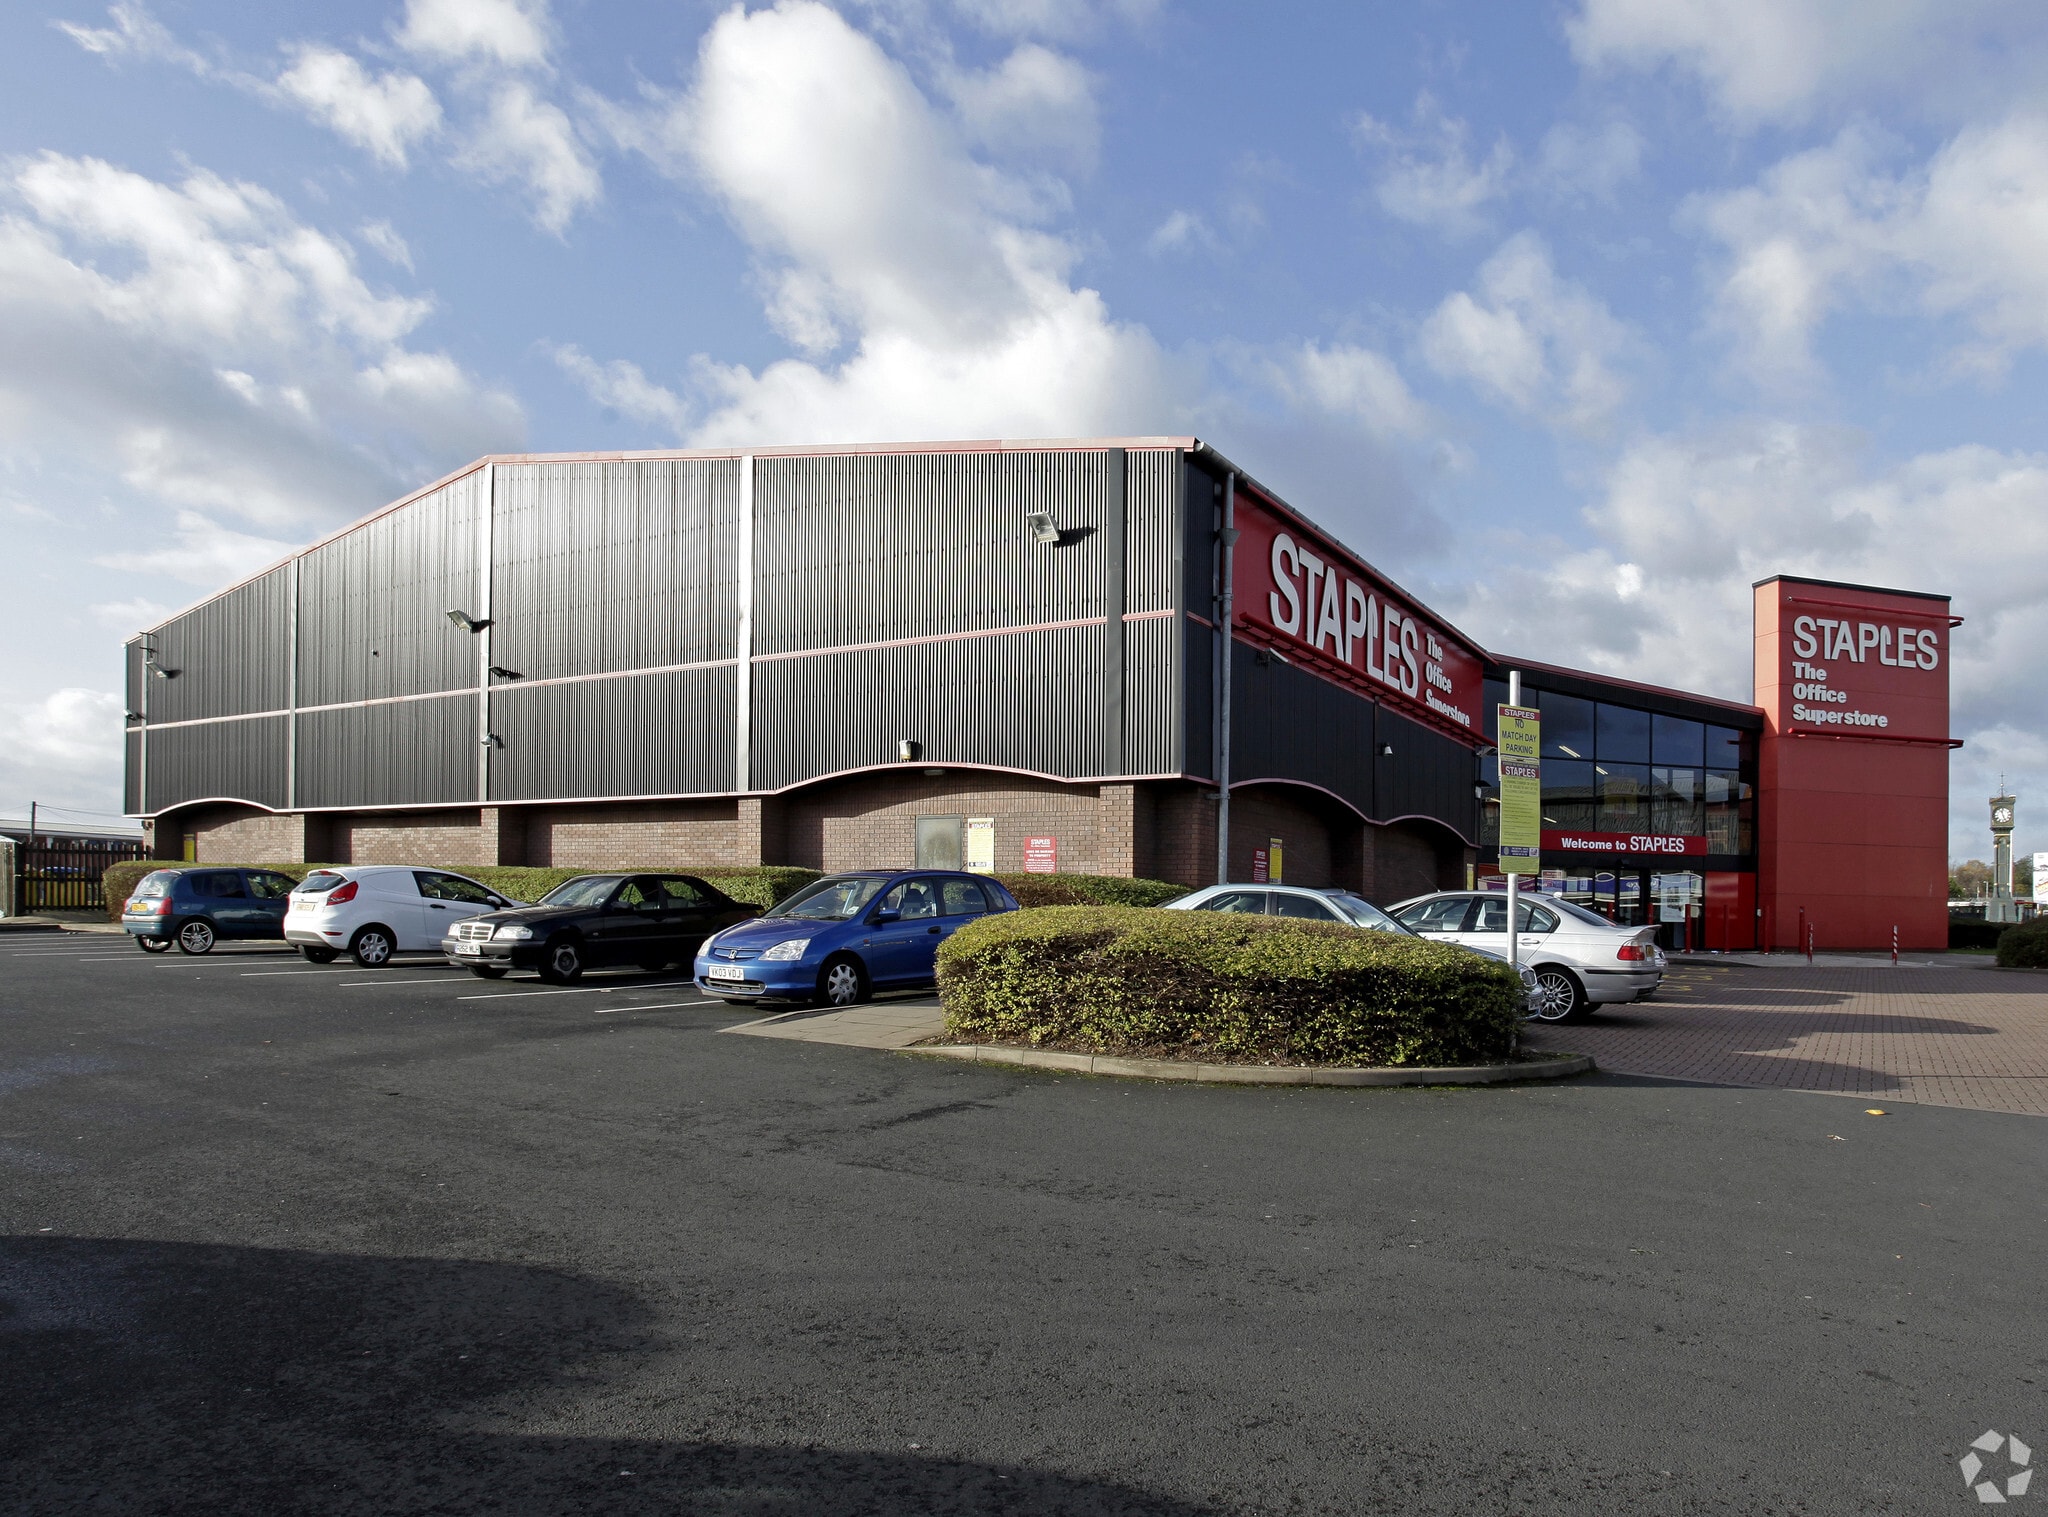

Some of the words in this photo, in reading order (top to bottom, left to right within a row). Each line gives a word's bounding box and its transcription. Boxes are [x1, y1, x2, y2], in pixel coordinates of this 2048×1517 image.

[1270, 533, 1418, 699] STAPLES
[1426, 632, 1443, 662] The
[1793, 615, 1939, 671] STAPLES
[1425, 661, 1452, 694] Office
[1792, 661, 1827, 681] The
[1792, 682, 1847, 704] Office
[1504, 708, 1535, 720] STAPLES
[1515, 718, 1525, 729] NO
[1792, 703, 1888, 728] Superstore
[1502, 730, 1524, 741] MATCH
[1524, 733, 1537, 742] DAY
[1505, 743, 1534, 755] PARKING
[1505, 765, 1536, 778] STAPLES
[1561, 837, 1613, 850] Welcome
[1615, 840, 1627, 850] to
[1630, 835, 1685, 853] STAPLES
